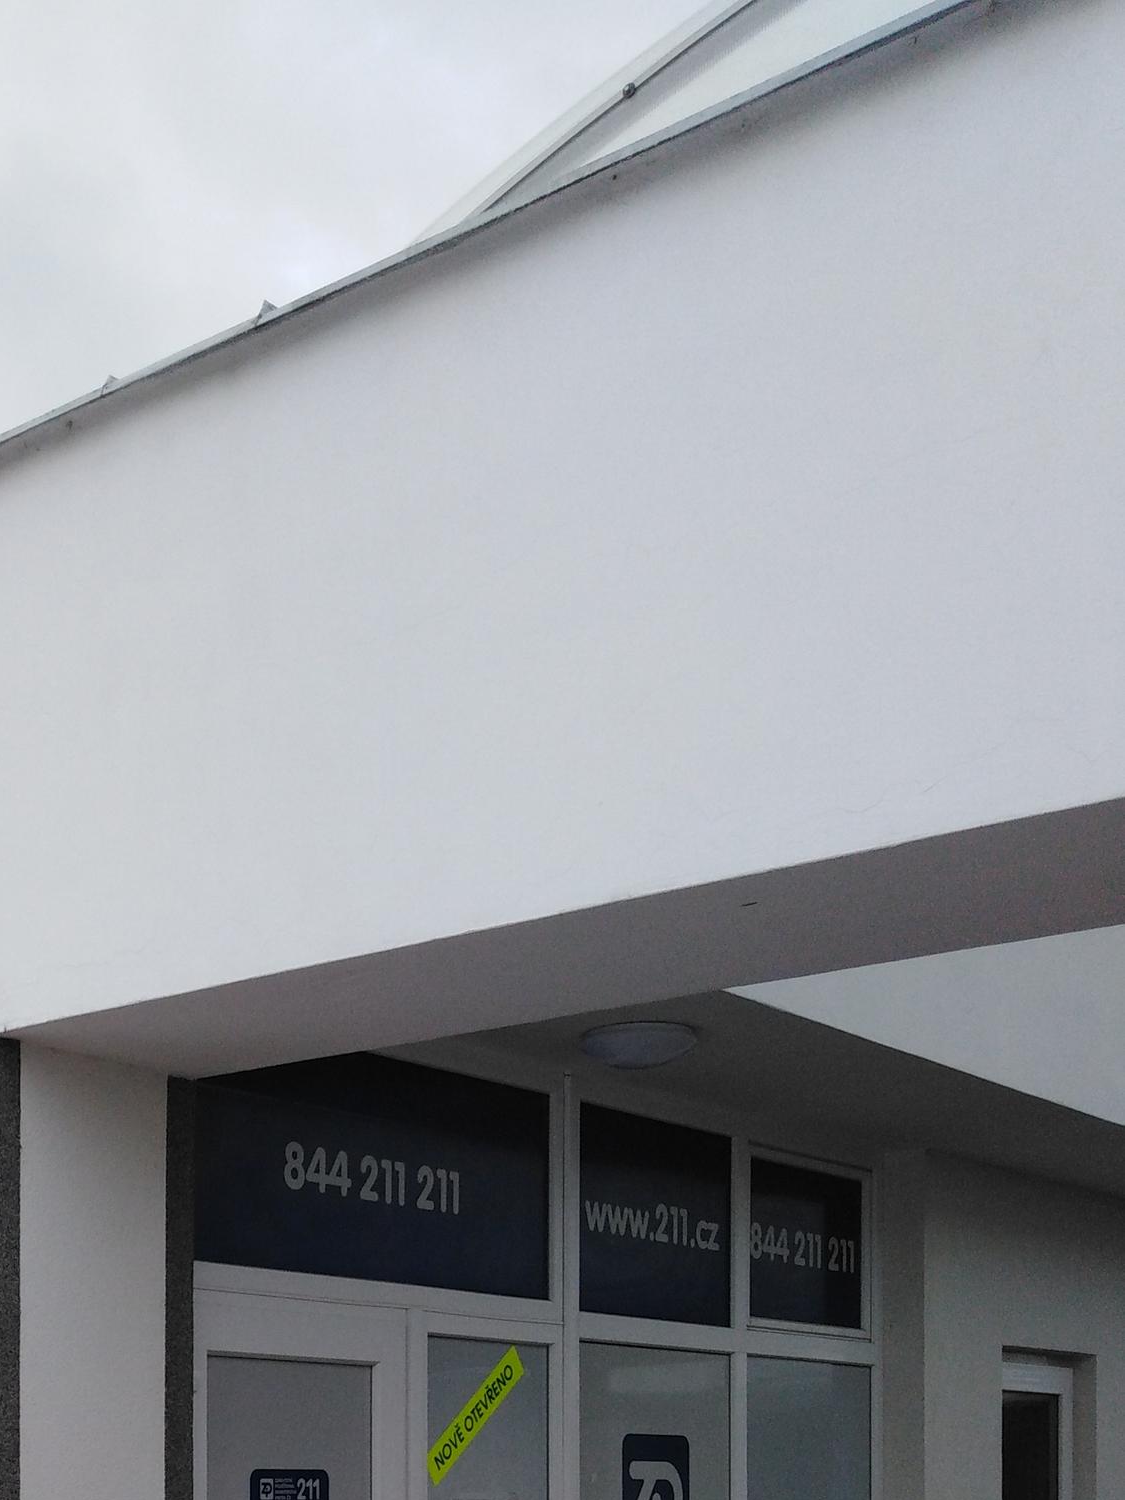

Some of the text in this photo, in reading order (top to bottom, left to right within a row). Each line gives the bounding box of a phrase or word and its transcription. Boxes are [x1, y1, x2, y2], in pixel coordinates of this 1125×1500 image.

[284, 1141, 460, 1215] 844 211 211
[585, 1200, 720, 1250] www.211.cz
[751, 1222, 855, 1274] 844 211 211
[434, 1365, 514, 1471] NOVĚ OTEVŘENO
[297, 1478, 320, 1500] 211
